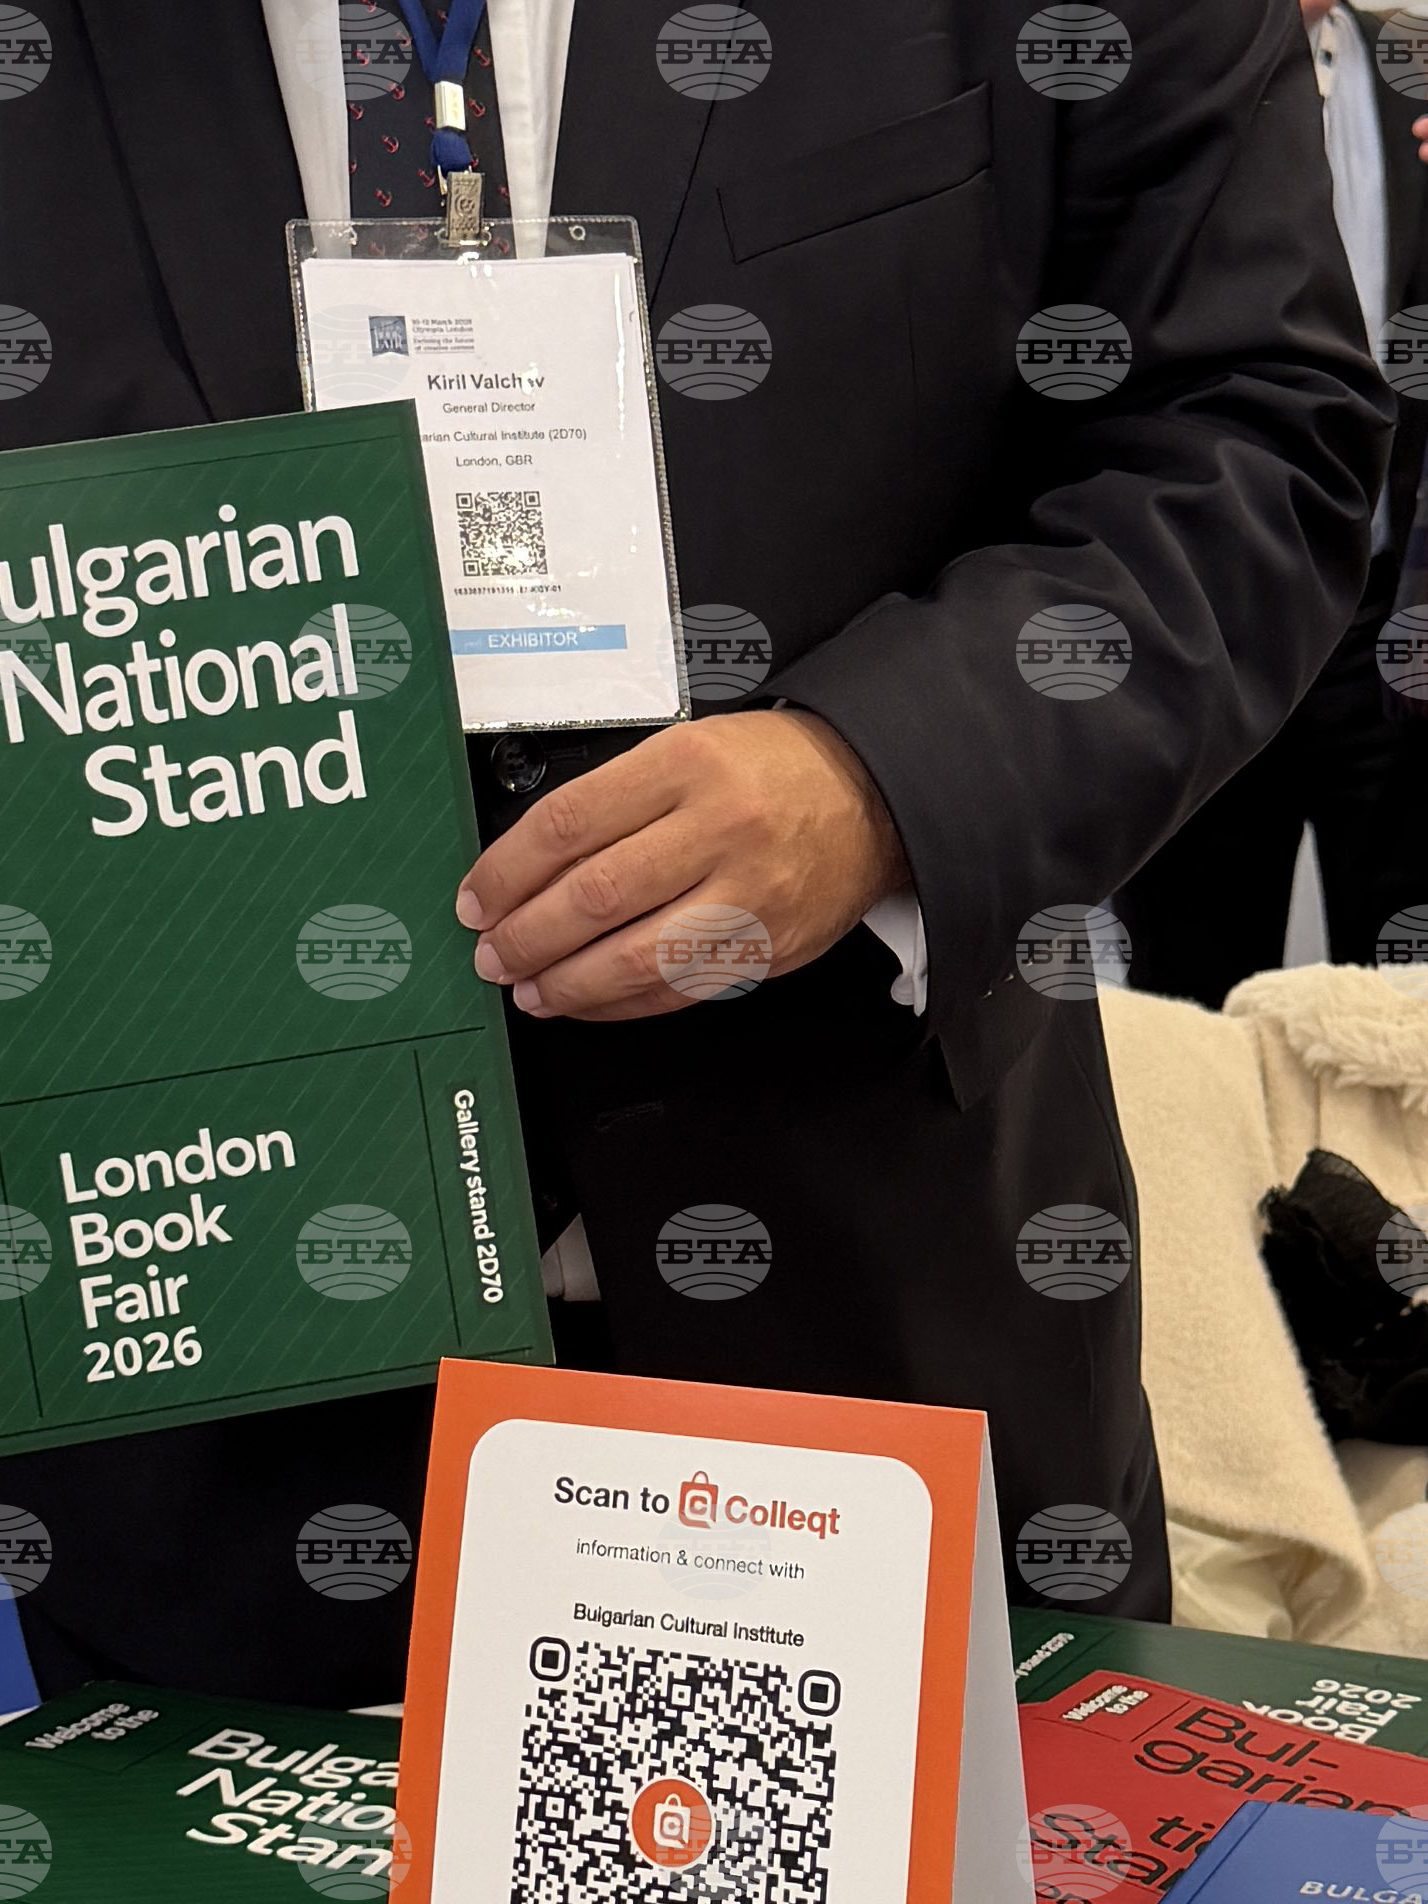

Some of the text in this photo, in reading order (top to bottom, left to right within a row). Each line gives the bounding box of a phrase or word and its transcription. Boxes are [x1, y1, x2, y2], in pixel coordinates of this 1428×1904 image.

[426, 373, 467, 391] Kiril
[442, 401, 536, 415] General Director
[421, 430, 451, 443] arian
[453, 430, 498, 442] Cultural
[501, 429, 545, 441] Institute
[455, 455, 503, 468] London,
[486, 630, 580, 649] EXHIBITOR
[83, 708, 367, 839] Stand
[58, 1127, 297, 1205] London
[453, 1088, 505, 1304] Gallery stand 2D70
[68, 1192, 233, 1268] Book
[79, 1266, 190, 1331] Fair
[82, 1325, 204, 1383] 2026
[553, 1475, 841, 1540] Scan to Colleqt
[575, 1537, 806, 1581] information & connect with
[572, 1602, 806, 1648] Bulgarian Cultural Institute
[24, 1701, 132, 1751] Welcome
[89, 1708, 160, 1742] to the
[1173, 1706, 1340, 1770] Bul-
[187, 1727, 400, 1789] Bulga
[175, 1767, 397, 1836] Natio
[185, 1811, 395, 1878] Stan
